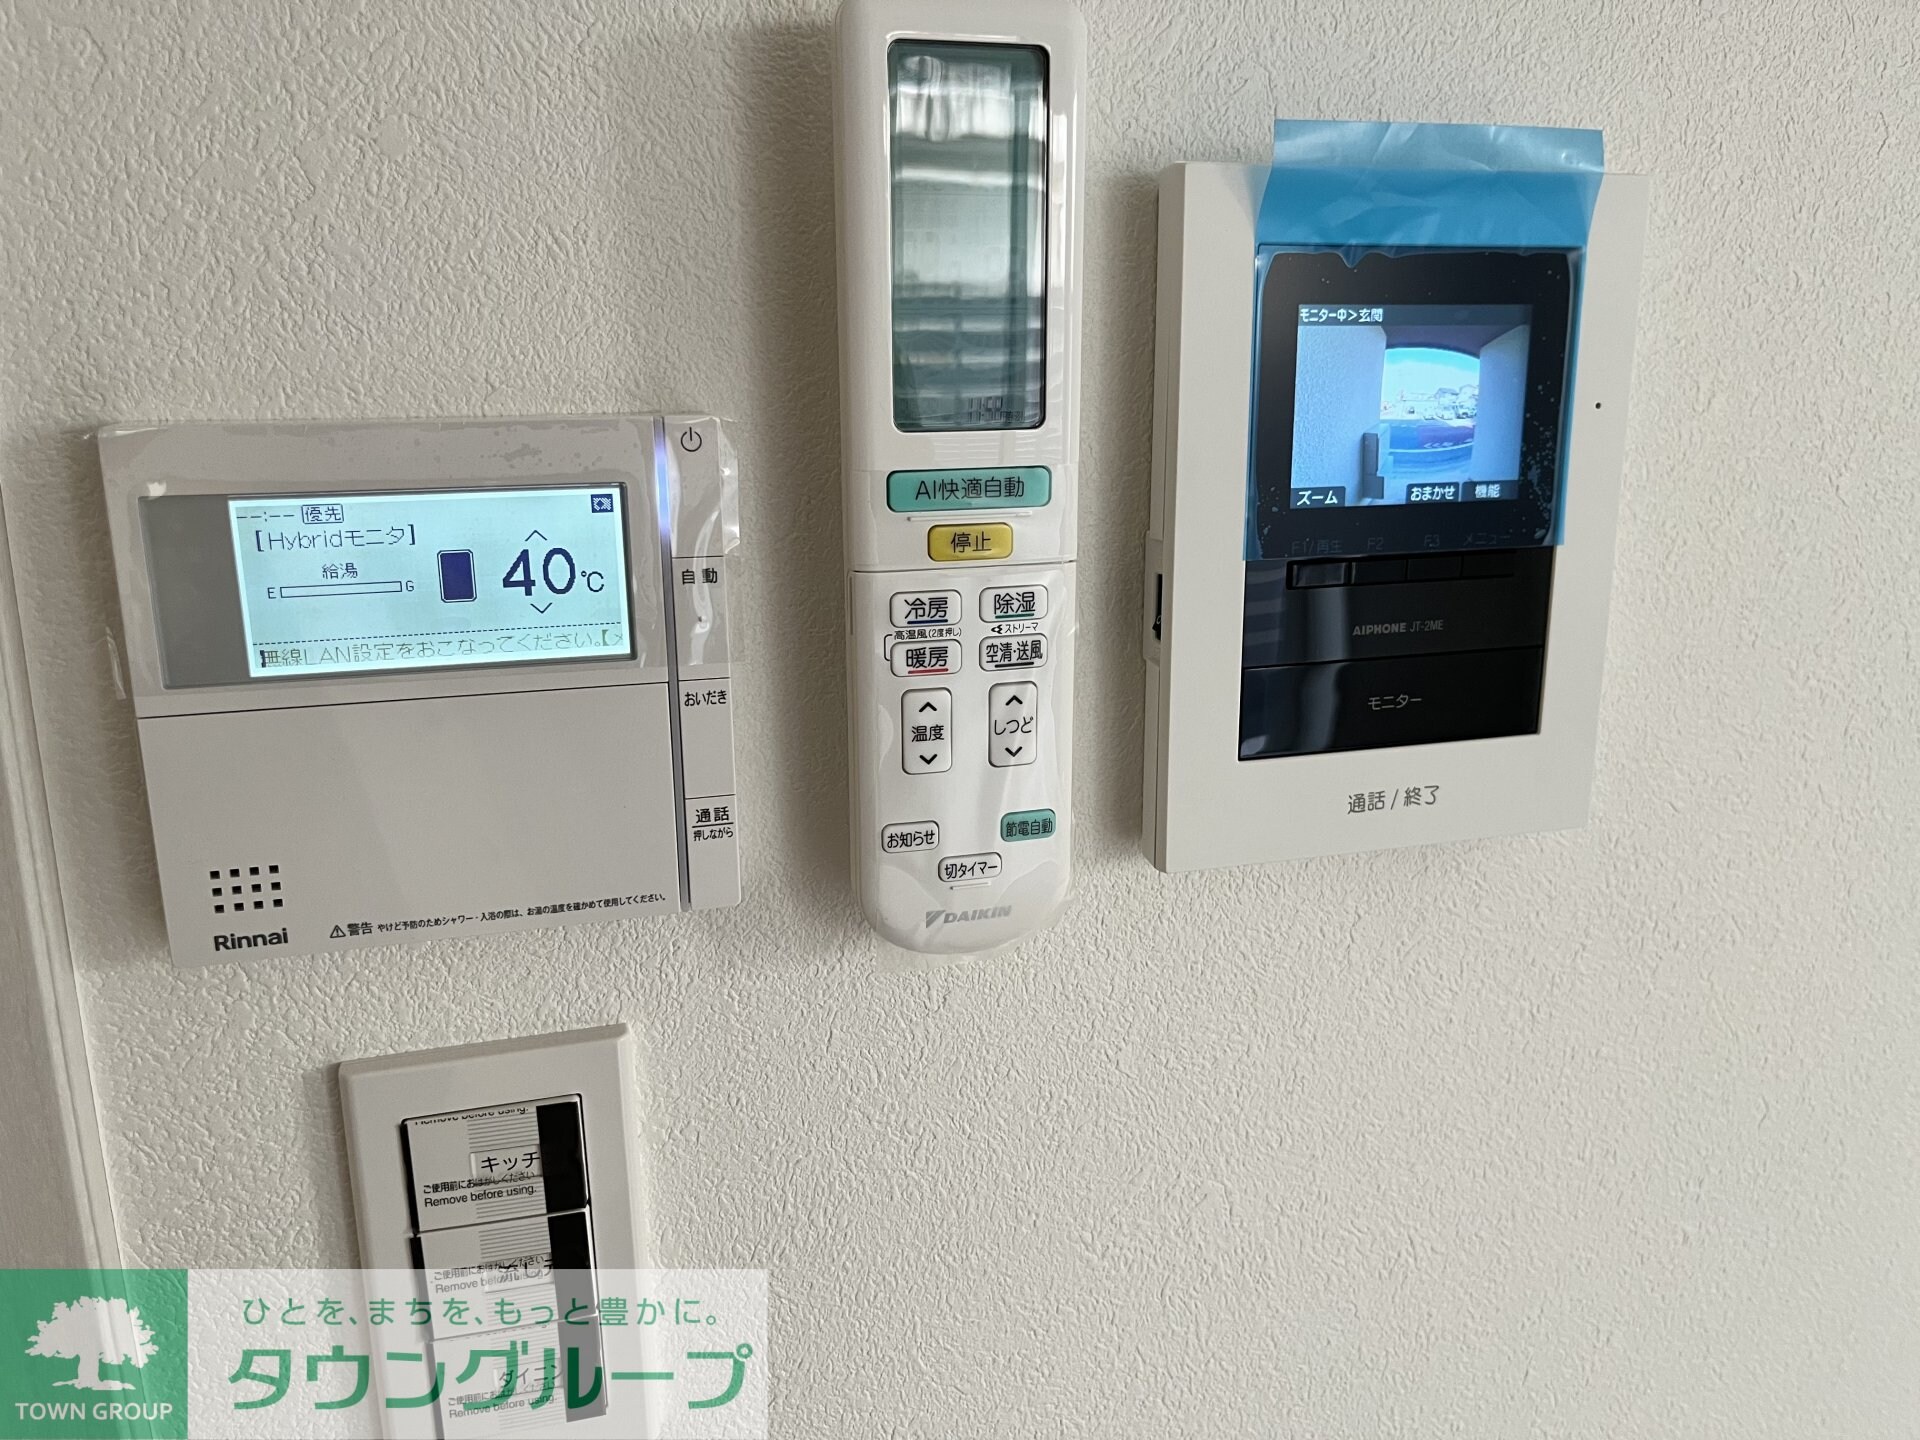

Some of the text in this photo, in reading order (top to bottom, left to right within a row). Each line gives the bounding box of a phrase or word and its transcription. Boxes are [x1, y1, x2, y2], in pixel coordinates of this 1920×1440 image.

[915, 476, 1025, 500] AI快適自動
[1410, 485, 1456, 501] おまかせ
[1474, 484, 1500, 498] 機能
[1296, 490, 1339, 506] ズーム
[305, 506, 342, 522] 優先
[950, 531, 992, 553] 停止
[1367, 537, 1384, 550] F2
[1424, 534, 1441, 547] F3
[1463, 532, 1511, 545] メニュー
[322, 563, 358, 579] 給湯
[681, 568, 718, 585] 自動
[267, 587, 277, 599] E
[405, 581, 415, 592] G
[904, 597, 948, 619] 冷房
[994, 591, 1035, 614] 除湿
[1005, 622, 1039, 633] ストリーマ
[1353, 620, 1444, 636] AIPHONE JT-2ME
[906, 646, 948, 668] 暖房
[684, 690, 727, 706] おいだき
[1368, 694, 1422, 710] モニター
[911, 724, 944, 742] 温度
[994, 717, 1033, 735] しつど
[695, 806, 729, 823] 通話
[693, 827, 733, 841] 押しながら
[1005, 818, 1052, 837] 節電自動
[887, 830, 935, 849] お知らせ
[944, 861, 998, 879] 切タイマー
[943, 905, 1012, 924] DAIKIN
[347, 922, 373, 936] 警告
[214, 928, 288, 951] Rinnai
[481, 1151, 540, 1173] キッチ
[424, 1185, 537, 1208] Remove before using.
[436, 1280, 478, 1293] Remove
